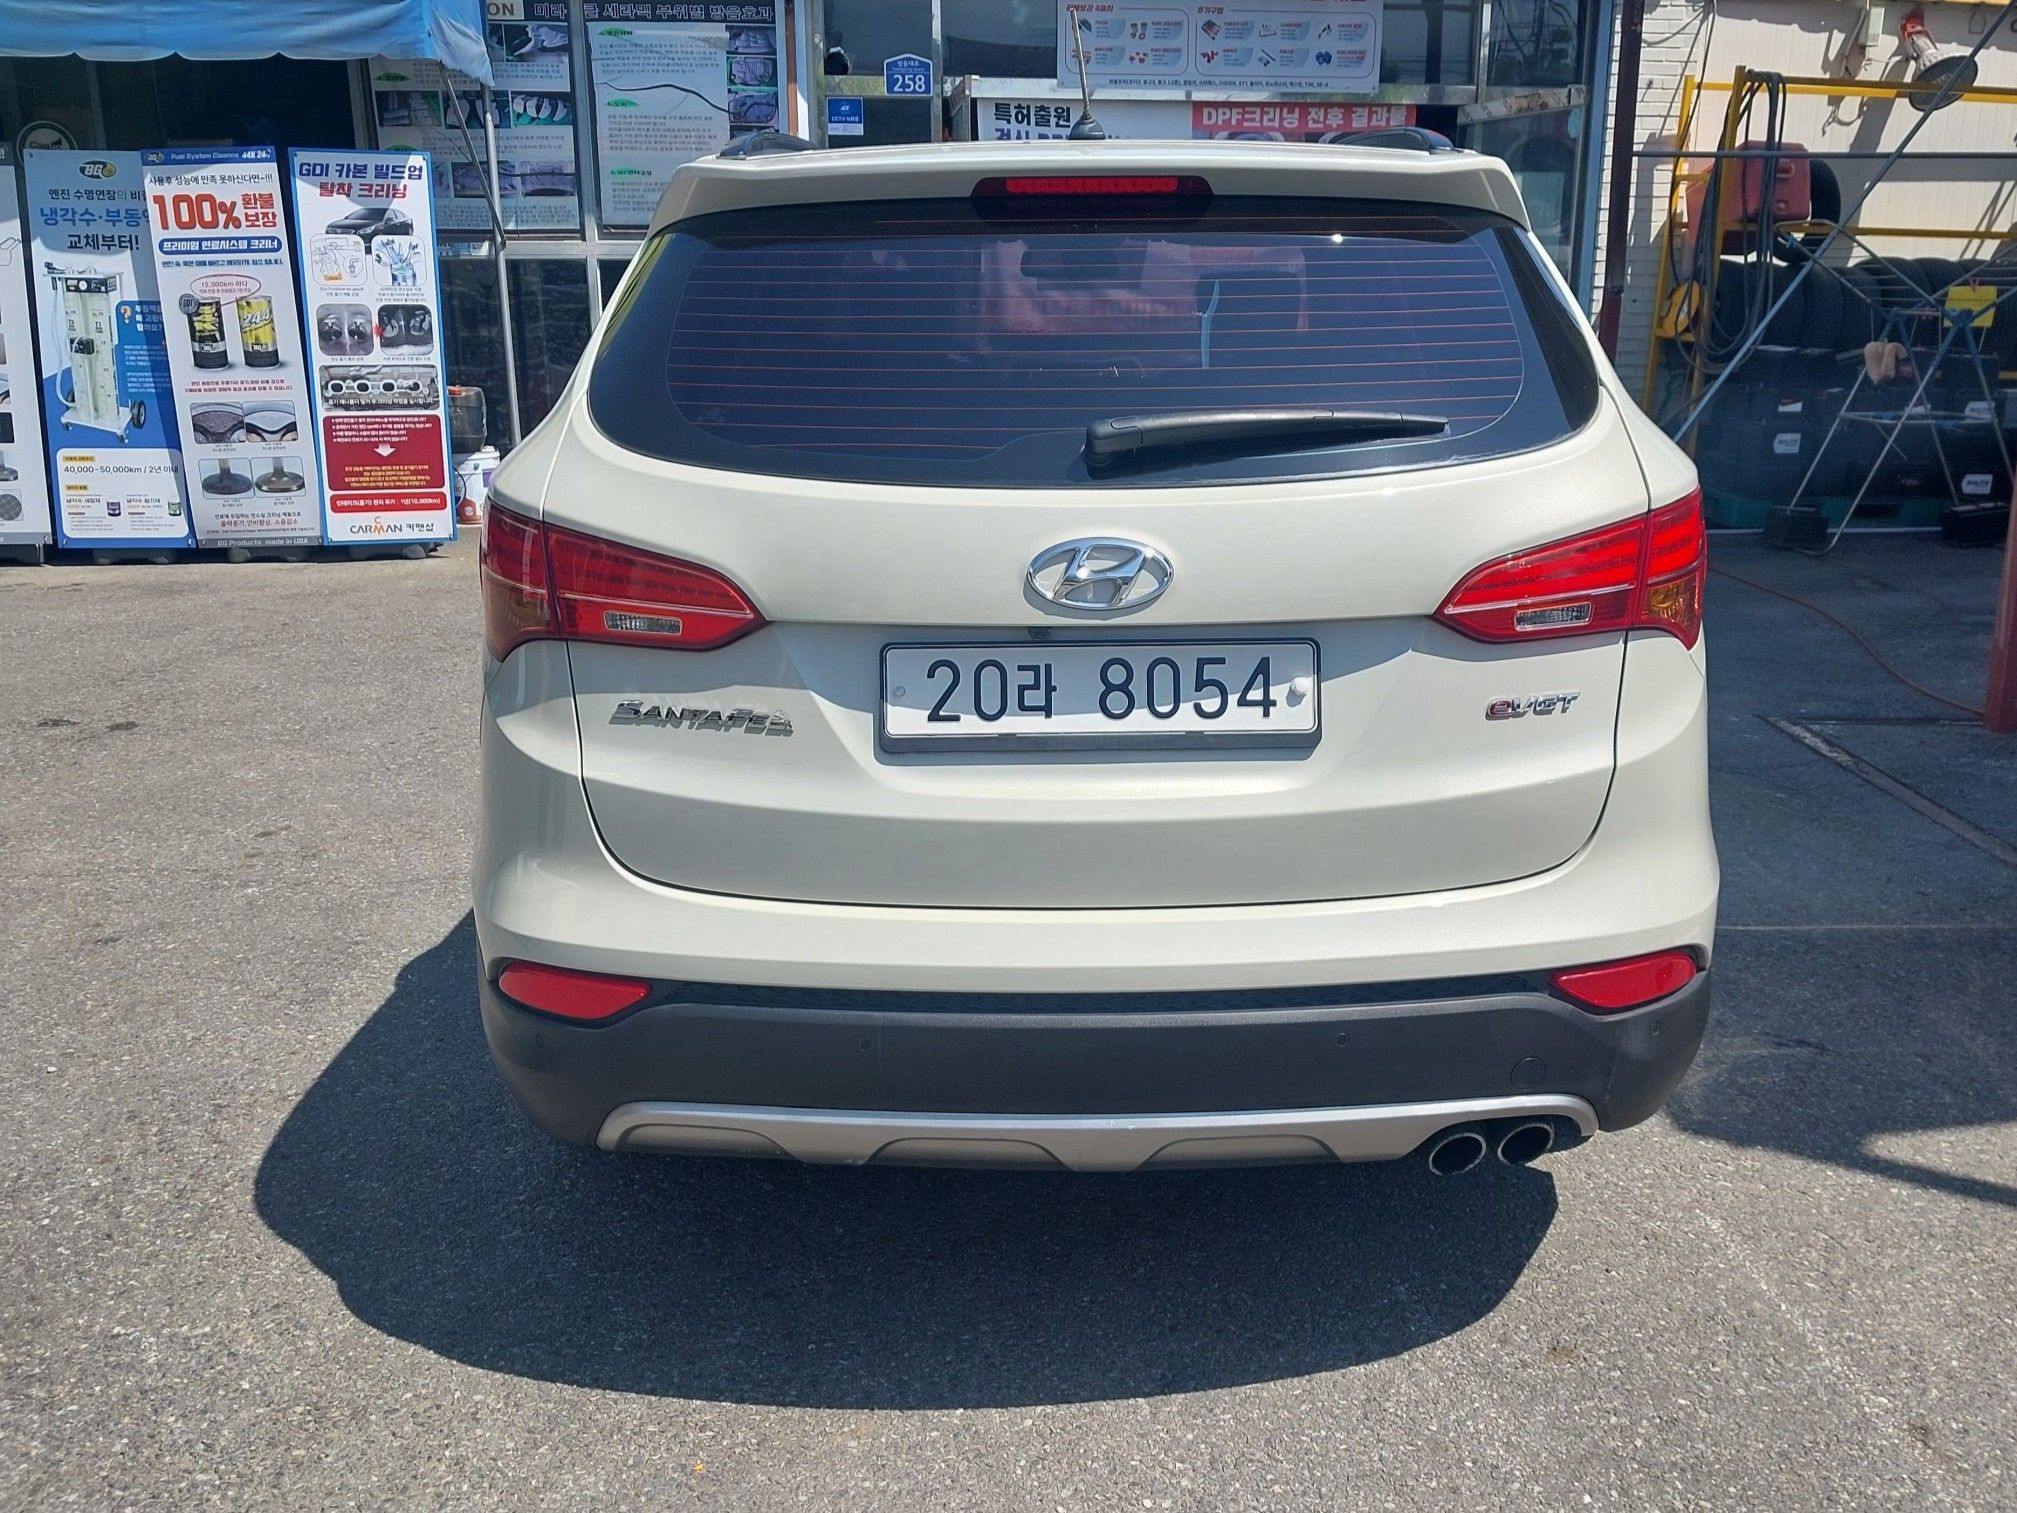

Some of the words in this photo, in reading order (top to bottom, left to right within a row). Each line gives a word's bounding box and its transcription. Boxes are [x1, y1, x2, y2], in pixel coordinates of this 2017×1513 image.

[603, 3, 652, 18] 세라믹
[655, 4, 705, 19] 부위별
[709, 5, 774, 20] 방음효과
[893, 74, 926, 92] 258
[994, 102, 1072, 128] 특허출원
[1203, 106, 1300, 128] DPF크리닝
[1308, 106, 1344, 128] 전후
[1352, 106, 1407, 128] 결과물
[299, 162, 330, 177] GDI
[335, 163, 368, 179] 카본
[374, 163, 423, 180] 빌드업
[149, 175, 172, 186] 사용후
[175, 175, 199, 185] 성능에
[201, 175, 217, 185] 만족
[48, 188, 70, 200] 엔진
[73, 188, 127, 201] 수명연장의
[319, 182, 353, 198] 탈착
[357, 182, 407, 199] 크리닝
[241, 193, 275, 209] 환불
[152, 193, 242, 230] 100%
[244, 211, 277, 227] 보장
[67, 234, 140, 251] 교체부터!
[163, 241, 199, 251] 프리미엄
[201, 240, 247, 250] 연료시스템
[250, 239, 277, 249] 크리너
[201, 280, 234, 289] 15,000km
[236, 280, 248, 288] 마다
[149, 465, 161, 474] 2년
[350, 522, 402, 536] CARMAN
[406, 523, 435, 532] 카맨샵
[229, 538, 262, 546] Products
[926, 658, 1057, 722] 20라
[1099, 656, 1278, 720] 8054
[1486, 691, 1581, 719] eVGT
